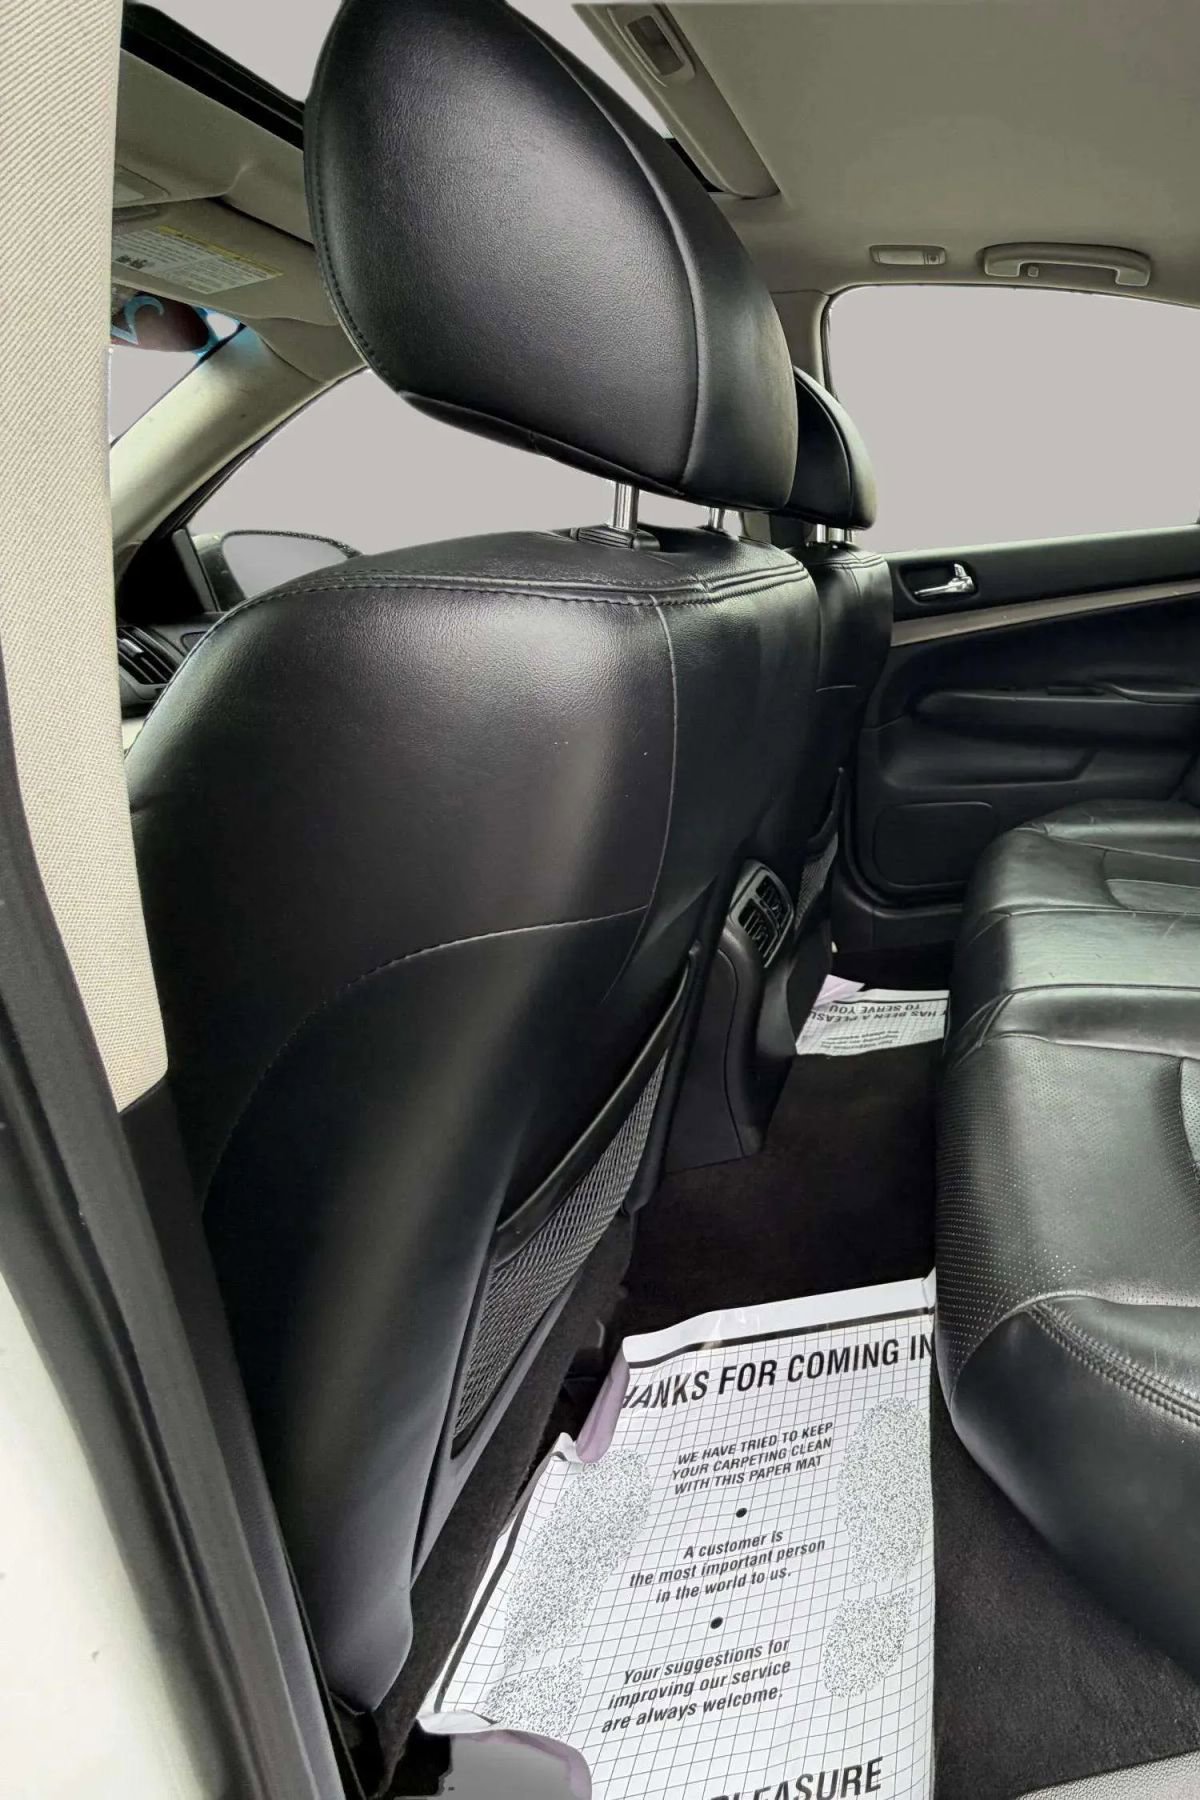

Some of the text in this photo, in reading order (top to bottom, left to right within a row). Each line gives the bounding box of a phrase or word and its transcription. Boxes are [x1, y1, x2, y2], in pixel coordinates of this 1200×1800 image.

[809, 1011, 858, 1022] PLEASU
[829, 1005, 856, 1015] YOU
[860, 1005, 902, 1014] SERVE
[622, 1333, 934, 1409] HANKS FOR COMING IN
[672, 1437, 832, 1480] YOUR CARPETING CLEAN
[678, 1422, 833, 1465] WE HAVE TRIED TO KEEP
[674, 1454, 824, 1495] WITH THIS PAPER MAT
[629, 1539, 826, 1588] the most important person
[683, 1530, 783, 1559] A customer is
[655, 1566, 792, 1603] in the world to us.
[624, 1638, 790, 1685] Your suggestions for
[608, 1661, 791, 1710] improving our service
[601, 1686, 783, 1734] are always welcome.
[711, 1756, 883, 1800] ASURE
